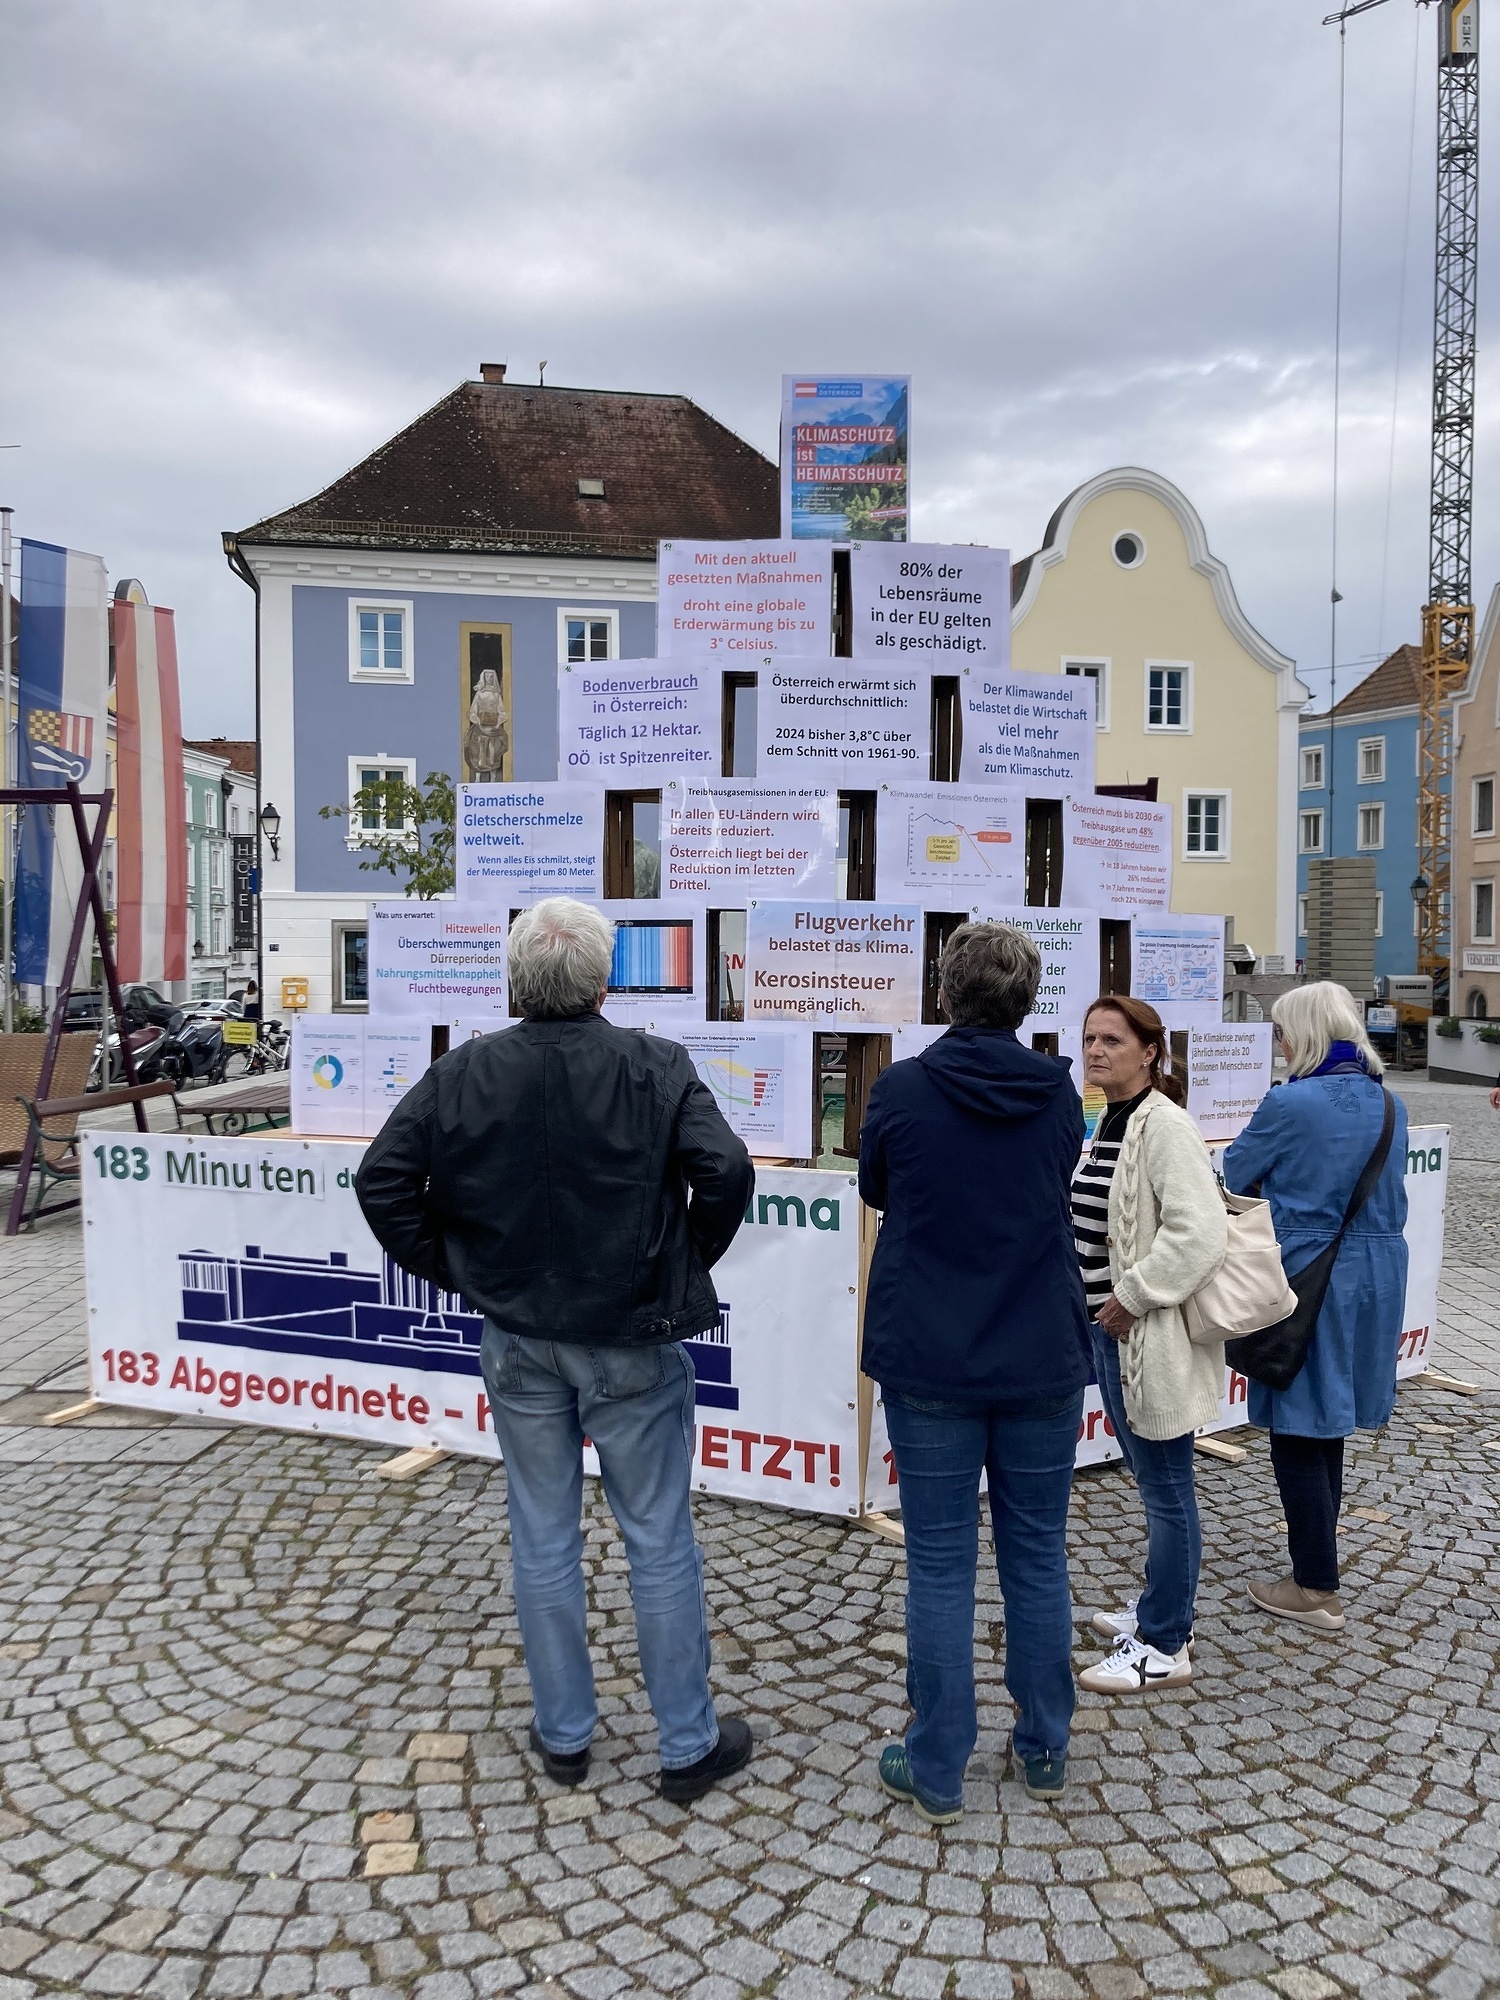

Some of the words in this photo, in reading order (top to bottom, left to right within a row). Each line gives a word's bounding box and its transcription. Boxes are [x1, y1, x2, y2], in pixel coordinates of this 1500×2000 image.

[797, 428, 894, 442] KLIMASCHUTZ
[797, 448, 813, 461] ist
[797, 468, 902, 481] HEIMATSCHUTZ
[695, 554, 718, 565] Mit
[722, 554, 746, 565] den
[751, 552, 797, 564] aktuell
[900, 562, 933, 577] 80%
[938, 564, 963, 579] der
[668, 573, 732, 585] gesetzten
[737, 571, 822, 584] Maßnahmen
[880, 585, 982, 604] Lebensräume
[684, 600, 720, 611] droht
[725, 601, 753, 611] eine
[757, 599, 806, 614] globale
[871, 607, 884, 621] in
[889, 609, 914, 624] der
[919, 611, 939, 625] EU
[944, 612, 991, 629] gelten
[674, 618, 773, 633] Erderwärmung
[778, 618, 796, 630] bis
[800, 620, 815, 630] zu
[710, 638, 723, 649] 3°
[728, 639, 777, 650] Celsius.
[875, 632, 895, 646] als
[900, 635, 986, 653] geschädigt.
[582, 674, 698, 693] Bodenverbrauch
[772, 674, 834, 689] Österreich
[838, 679, 890, 690] erwärmt
[894, 680, 916, 690] sich
[984, 683, 1002, 695] Der
[1006, 685, 1073, 701] Klimawandel
[593, 701, 606, 713] in
[611, 697, 687, 713] Österreich:
[780, 693, 907, 708] überdurchschnittlich:
[969, 700, 1010, 715] belastet
[1014, 704, 1029, 716] die
[1033, 706, 1087, 720] Wirtschaft
[578, 726, 626, 742] Täglich
[631, 725, 647, 738] 12
[652, 723, 701, 737] Hektar.
[776, 728, 805, 740] 2024
[809, 729, 845, 741] bisher
[849, 731, 880, 743] 3,8°C
[884, 731, 911, 742] über
[998, 722, 1020, 737] viel
[1025, 725, 1058, 740] mehr
[568, 750, 590, 765] OÖ
[599, 753, 615, 765] ist
[620, 749, 712, 767] Spitzenreiter.
[767, 745, 793, 756] dem
[797, 746, 838, 757] Schnitt
[842, 750, 863, 758] von
[868, 748, 920, 759] 1961-90.
[979, 742, 993, 754] als
[996, 744, 1011, 755] die
[1014, 746, 1079, 760] Maßnahmen
[984, 764, 1006, 773] zum
[1010, 763, 1073, 778] Klimaschutz.
[688, 788, 786, 798] Treibhausgasemissionen
[815, 789, 828, 797] EU:
[890, 791, 936, 799] Klimawandel:
[937, 793, 972, 802] Emissionen
[974, 795, 1008, 803] Österreich
[464, 794, 544, 807] Dramatische
[464, 812, 583, 826] Gletscherschmelze
[671, 809, 681, 819] In
[685, 809, 714, 820] allen
[719, 809, 788, 820] EU-Ländern
[793, 810, 820, 821] wird
[1072, 802, 1104, 815] Österreich
[1106, 810, 1122, 818] muss
[1124, 810, 1133, 818] bis
[1136, 812, 1152, 820] 2030
[1153, 813, 1163, 822] die
[671, 825, 712, 836] bereits
[716, 826, 774, 836] reduziert.
[1081, 820, 1125, 834] Treibhausgase
[1139, 827, 1153, 836] 48%
[464, 833, 524, 845] weltweit.
[1073, 836, 1105, 846] gegenüber
[1107, 839, 1123, 847] 2005
[1124, 842, 1161, 851] reduzieren.
[670, 845, 732, 858] Österreich
[736, 847, 762, 861] liegt
[766, 848, 784, 859] bei
[788, 849, 808, 860] der
[478, 856, 501, 864] Wenn
[504, 856, 522, 864] alles
[525, 856, 535, 864] Eis
[538, 856, 572, 864] schmilzt,
[574, 856, 596, 865] steigt
[1121, 863, 1138, 871] Jahren
[1140, 863, 1156, 872] haben
[467, 868, 480, 876] der
[482, 868, 540, 878] Meeresspiegel
[558, 868, 567, 876] 80
[570, 868, 595, 876] Meter.
[670, 864, 731, 874] Reduktion
[735, 864, 750, 875] im
[754, 865, 795, 875] letzten
[237, 844, 250, 923] HOTEL
[670, 880, 711, 891] Drittel.
[752, 901, 757, 909] 9
[446, 924, 501, 934] Hitzewellen
[795, 912, 915, 934] Flugverkehr
[1036, 919, 1082, 931] Verkehr
[398, 937, 500, 951] Überschwemmungen
[769, 937, 830, 952] belastet
[835, 939, 861, 953] das
[866, 940, 914, 954] Klima.
[431, 954, 500, 965] Dürreperioden
[376, 968, 501, 981] Nahrungsmittelknappheit
[1046, 963, 1066, 976] der
[754, 970, 895, 990] Kerosinsteuer
[408, 983, 501, 996] Fluchtbewegungen
[753, 997, 866, 1013] unumgänglich.
[1192, 1033, 1202, 1042] Die
[1204, 1034, 1233, 1042] Klimakrise
[1235, 1033, 1255, 1043] zwingt
[1192, 1048, 1213, 1059] jährlich
[1232, 1048, 1240, 1056] als
[1242, 1047, 1249, 1056] 20
[1192, 1063, 1218, 1072] Millionen
[1220, 1062, 1252, 1070] Menschen
[1192, 1078, 1210, 1087] Flucht.
[1213, 1099, 1241, 1109] Prognosen
[1217, 1111, 1236, 1119] starken
[94, 1144, 150, 1181] 183
[102, 1348, 161, 1386] 183
[169, 1355, 431, 1424] Abgeordnete
[692, 1424, 841, 1488] ETZT!
